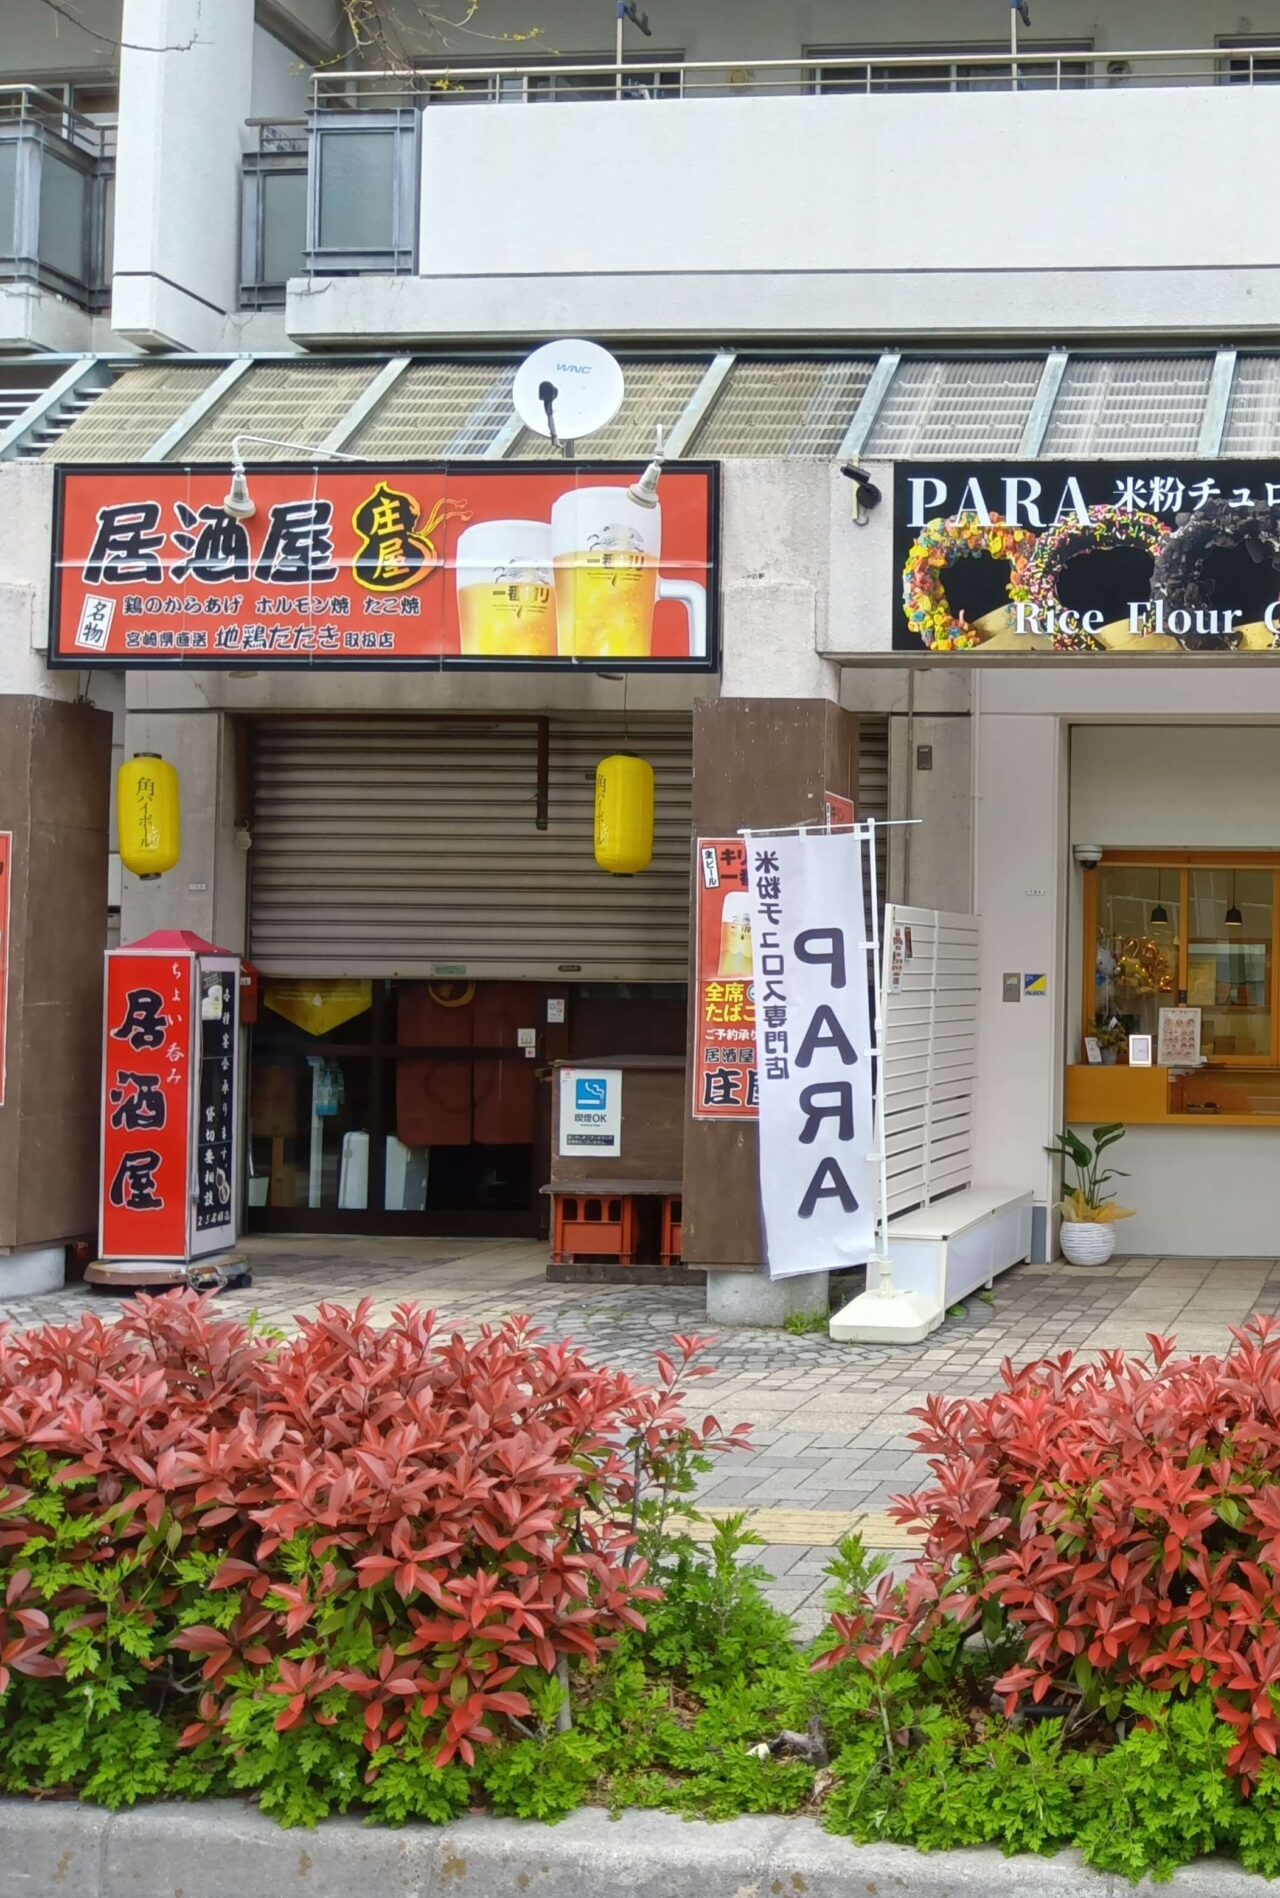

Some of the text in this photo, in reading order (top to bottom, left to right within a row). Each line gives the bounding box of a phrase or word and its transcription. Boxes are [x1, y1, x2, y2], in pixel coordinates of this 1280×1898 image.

[556, 363, 592, 374] WNC
[906, 475, 1095, 528] PARA
[82, 499, 340, 585] 居酒屋
[372, 496, 412, 580] 庄屋
[83, 602, 108, 643] 名物
[123, 595, 421, 617] 鶏のからあげ ホルモン焼 たこ焼
[1014, 600, 1105, 635] Rice
[1127, 600, 1243, 635] Flour
[136, 776, 155, 848] 角ハイボール
[704, 982, 745, 1003] 全席
[705, 1048, 754, 1063] 居酒屋
[110, 988, 168, 1211] 居酒屋
